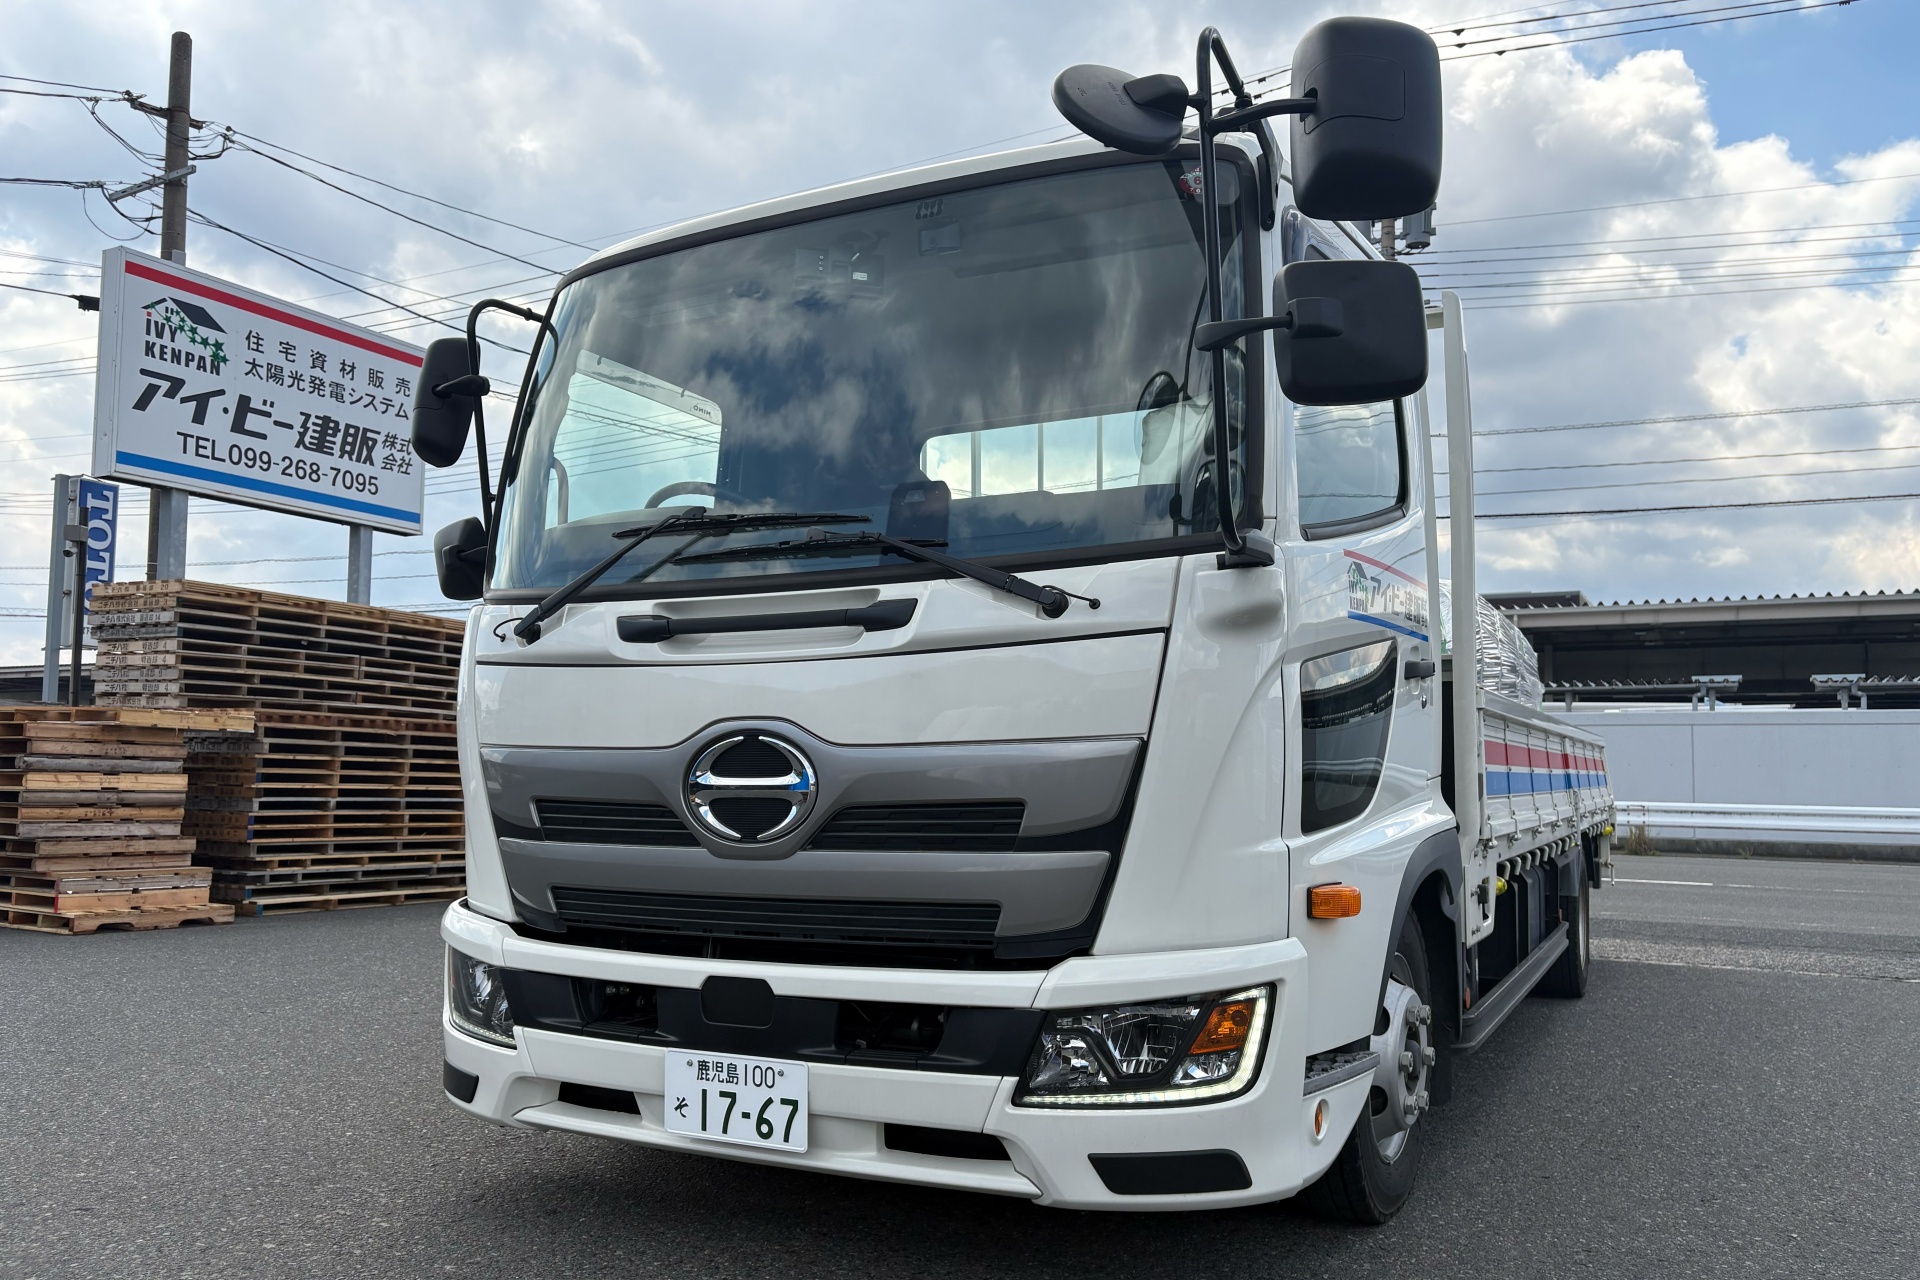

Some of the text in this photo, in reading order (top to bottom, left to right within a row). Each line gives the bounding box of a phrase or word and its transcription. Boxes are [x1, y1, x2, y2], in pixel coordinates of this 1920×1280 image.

[144, 340, 221, 376] KENPAN
[244, 358, 409, 420] 太陽光発電システム
[245, 329, 411, 398] 住宅資材販売
[132, 368, 381, 467] アイ・ビー建販
[674, 1089, 799, 1143] そ 17-67
